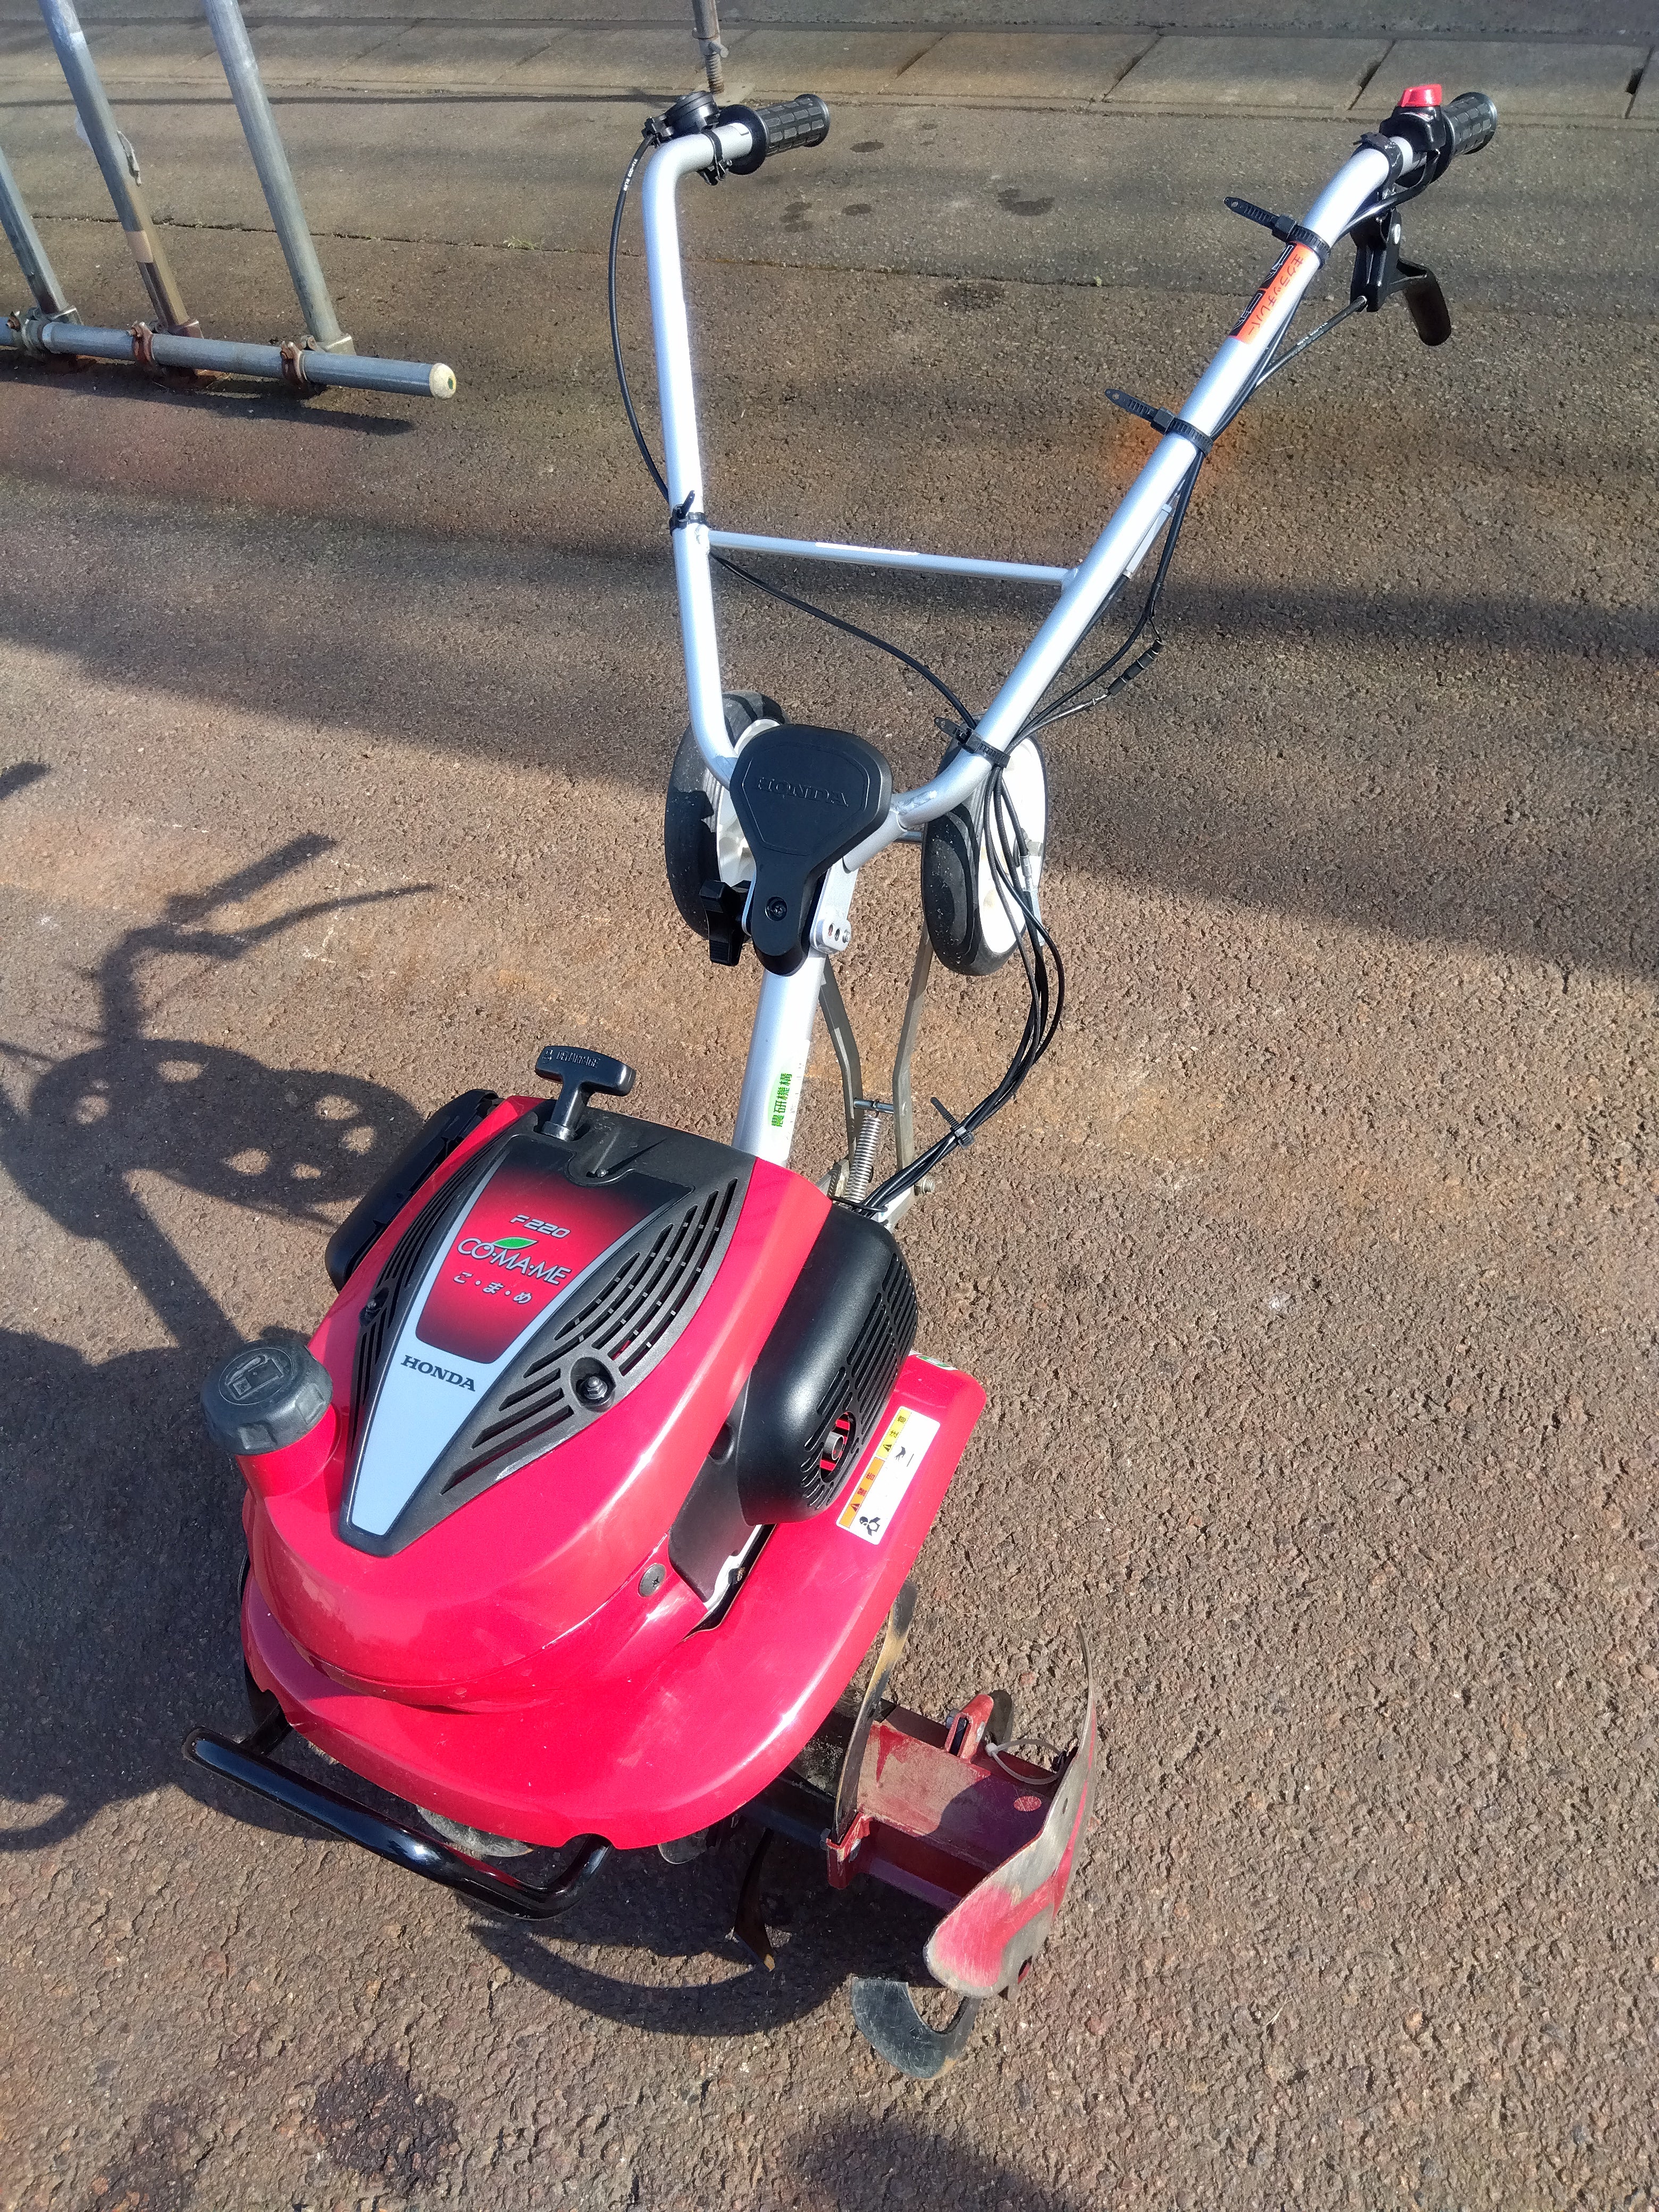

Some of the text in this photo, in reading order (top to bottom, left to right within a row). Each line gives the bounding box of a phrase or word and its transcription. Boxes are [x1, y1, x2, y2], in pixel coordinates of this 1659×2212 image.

[1248, 254, 1304, 336] 主クラッチレバー
[758, 776, 849, 807] HONDA
[771, 1073, 793, 1127] 農研機構
[509, 1213, 572, 1239] F220
[400, 1354, 476, 1392] HONDA
[889, 1415, 907, 1438] 注意
[857, 1471, 876, 1497] 警告
